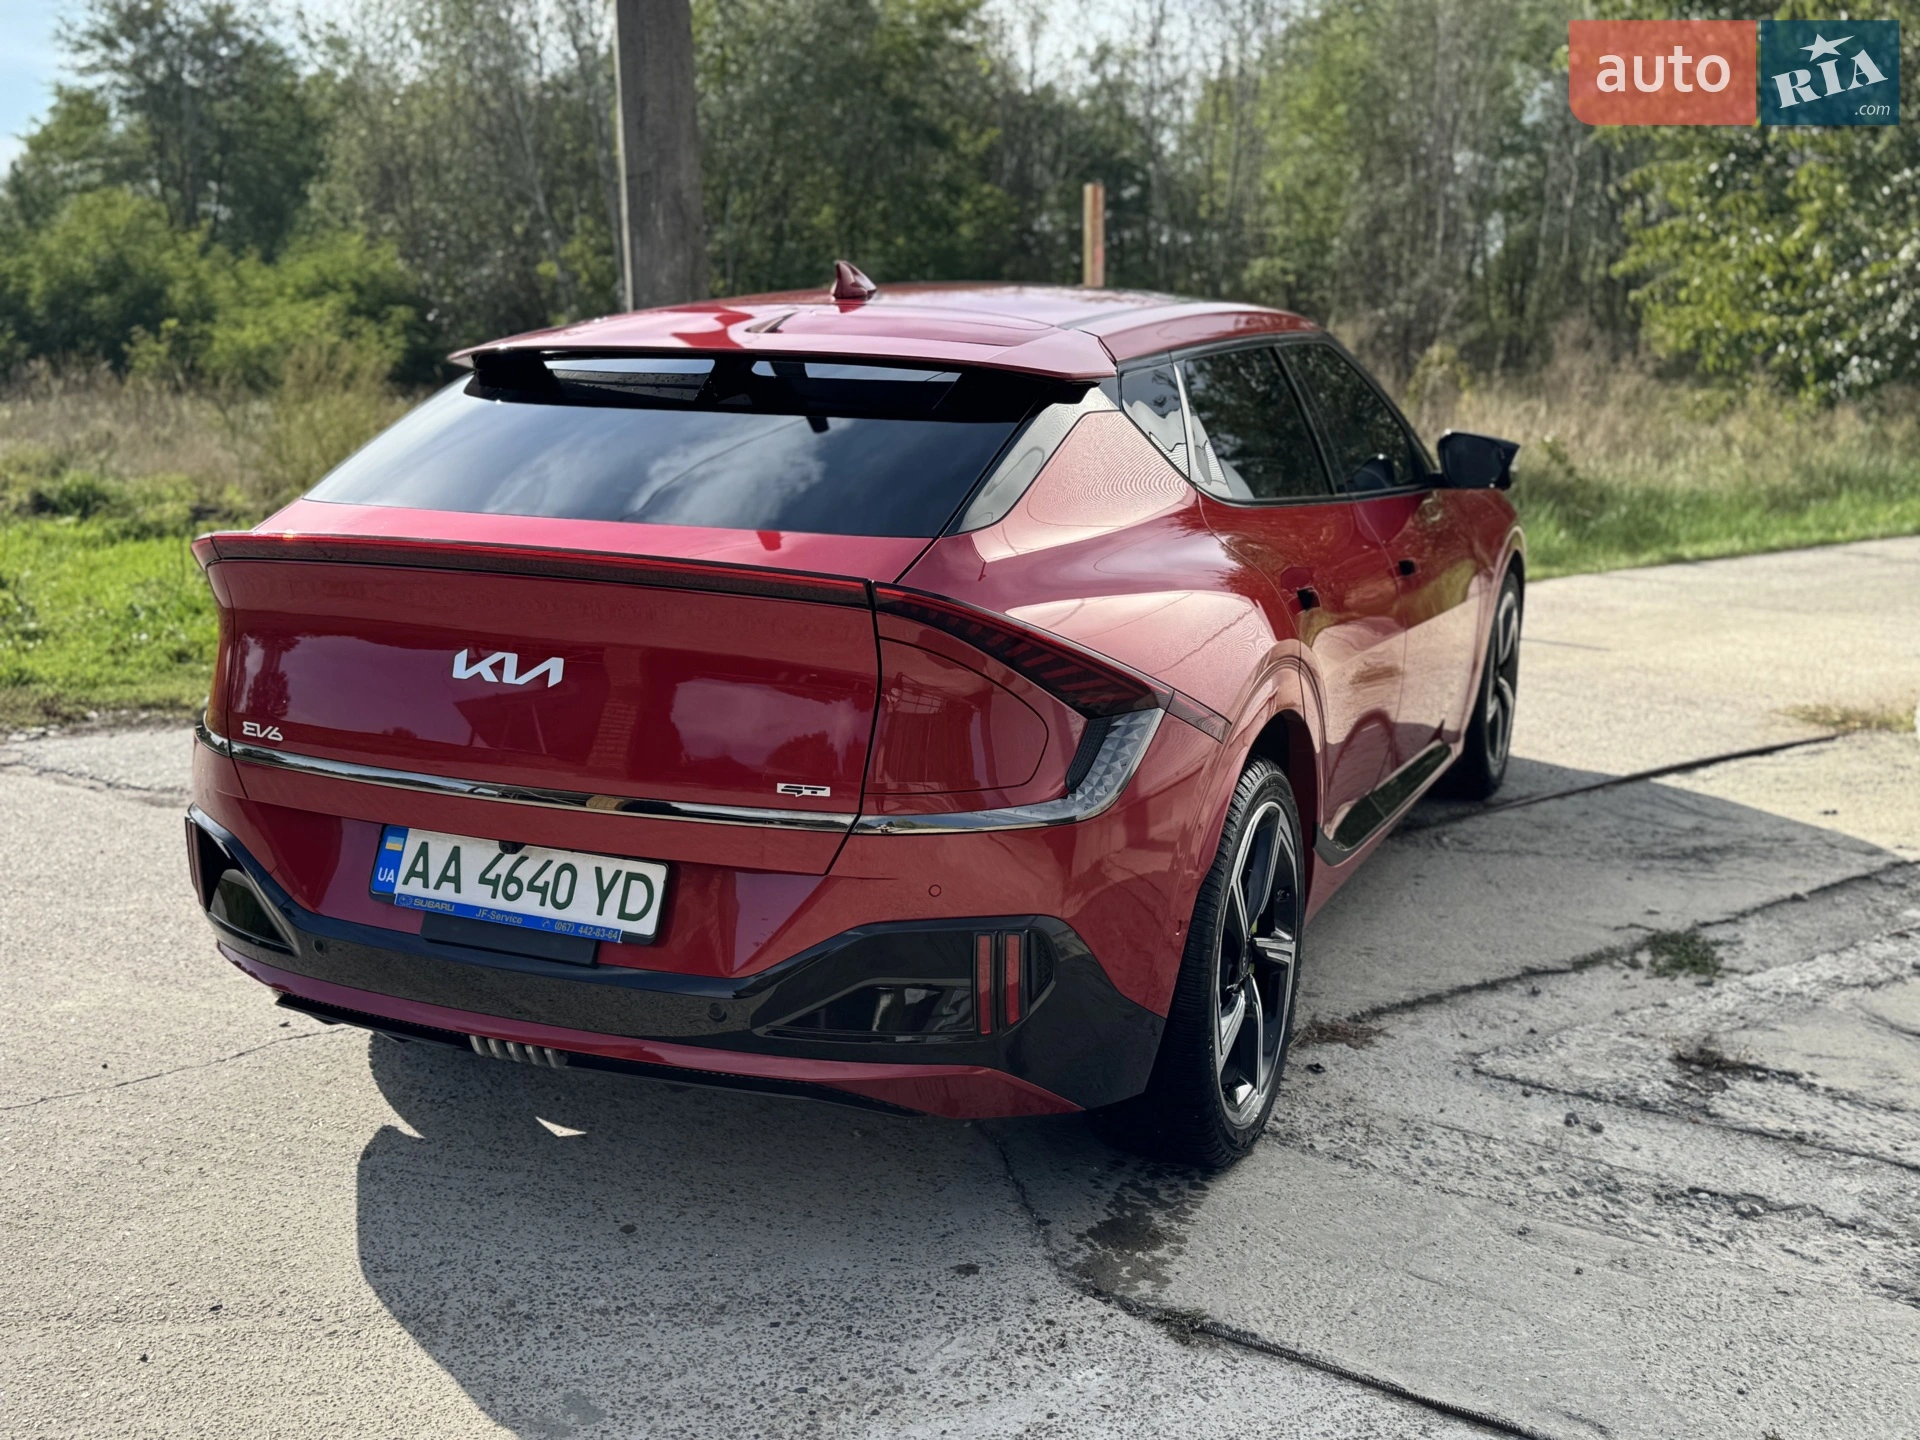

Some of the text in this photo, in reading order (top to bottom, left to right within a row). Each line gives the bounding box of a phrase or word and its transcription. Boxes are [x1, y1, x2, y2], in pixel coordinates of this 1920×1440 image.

[452, 648, 565, 688] KIA
[242, 721, 284, 742] EV6
[377, 867, 395, 884] UA
[401, 841, 654, 921] AA 4640 YD
[413, 898, 455, 912] SUBARU
[475, 909, 523, 924] JF-Service
